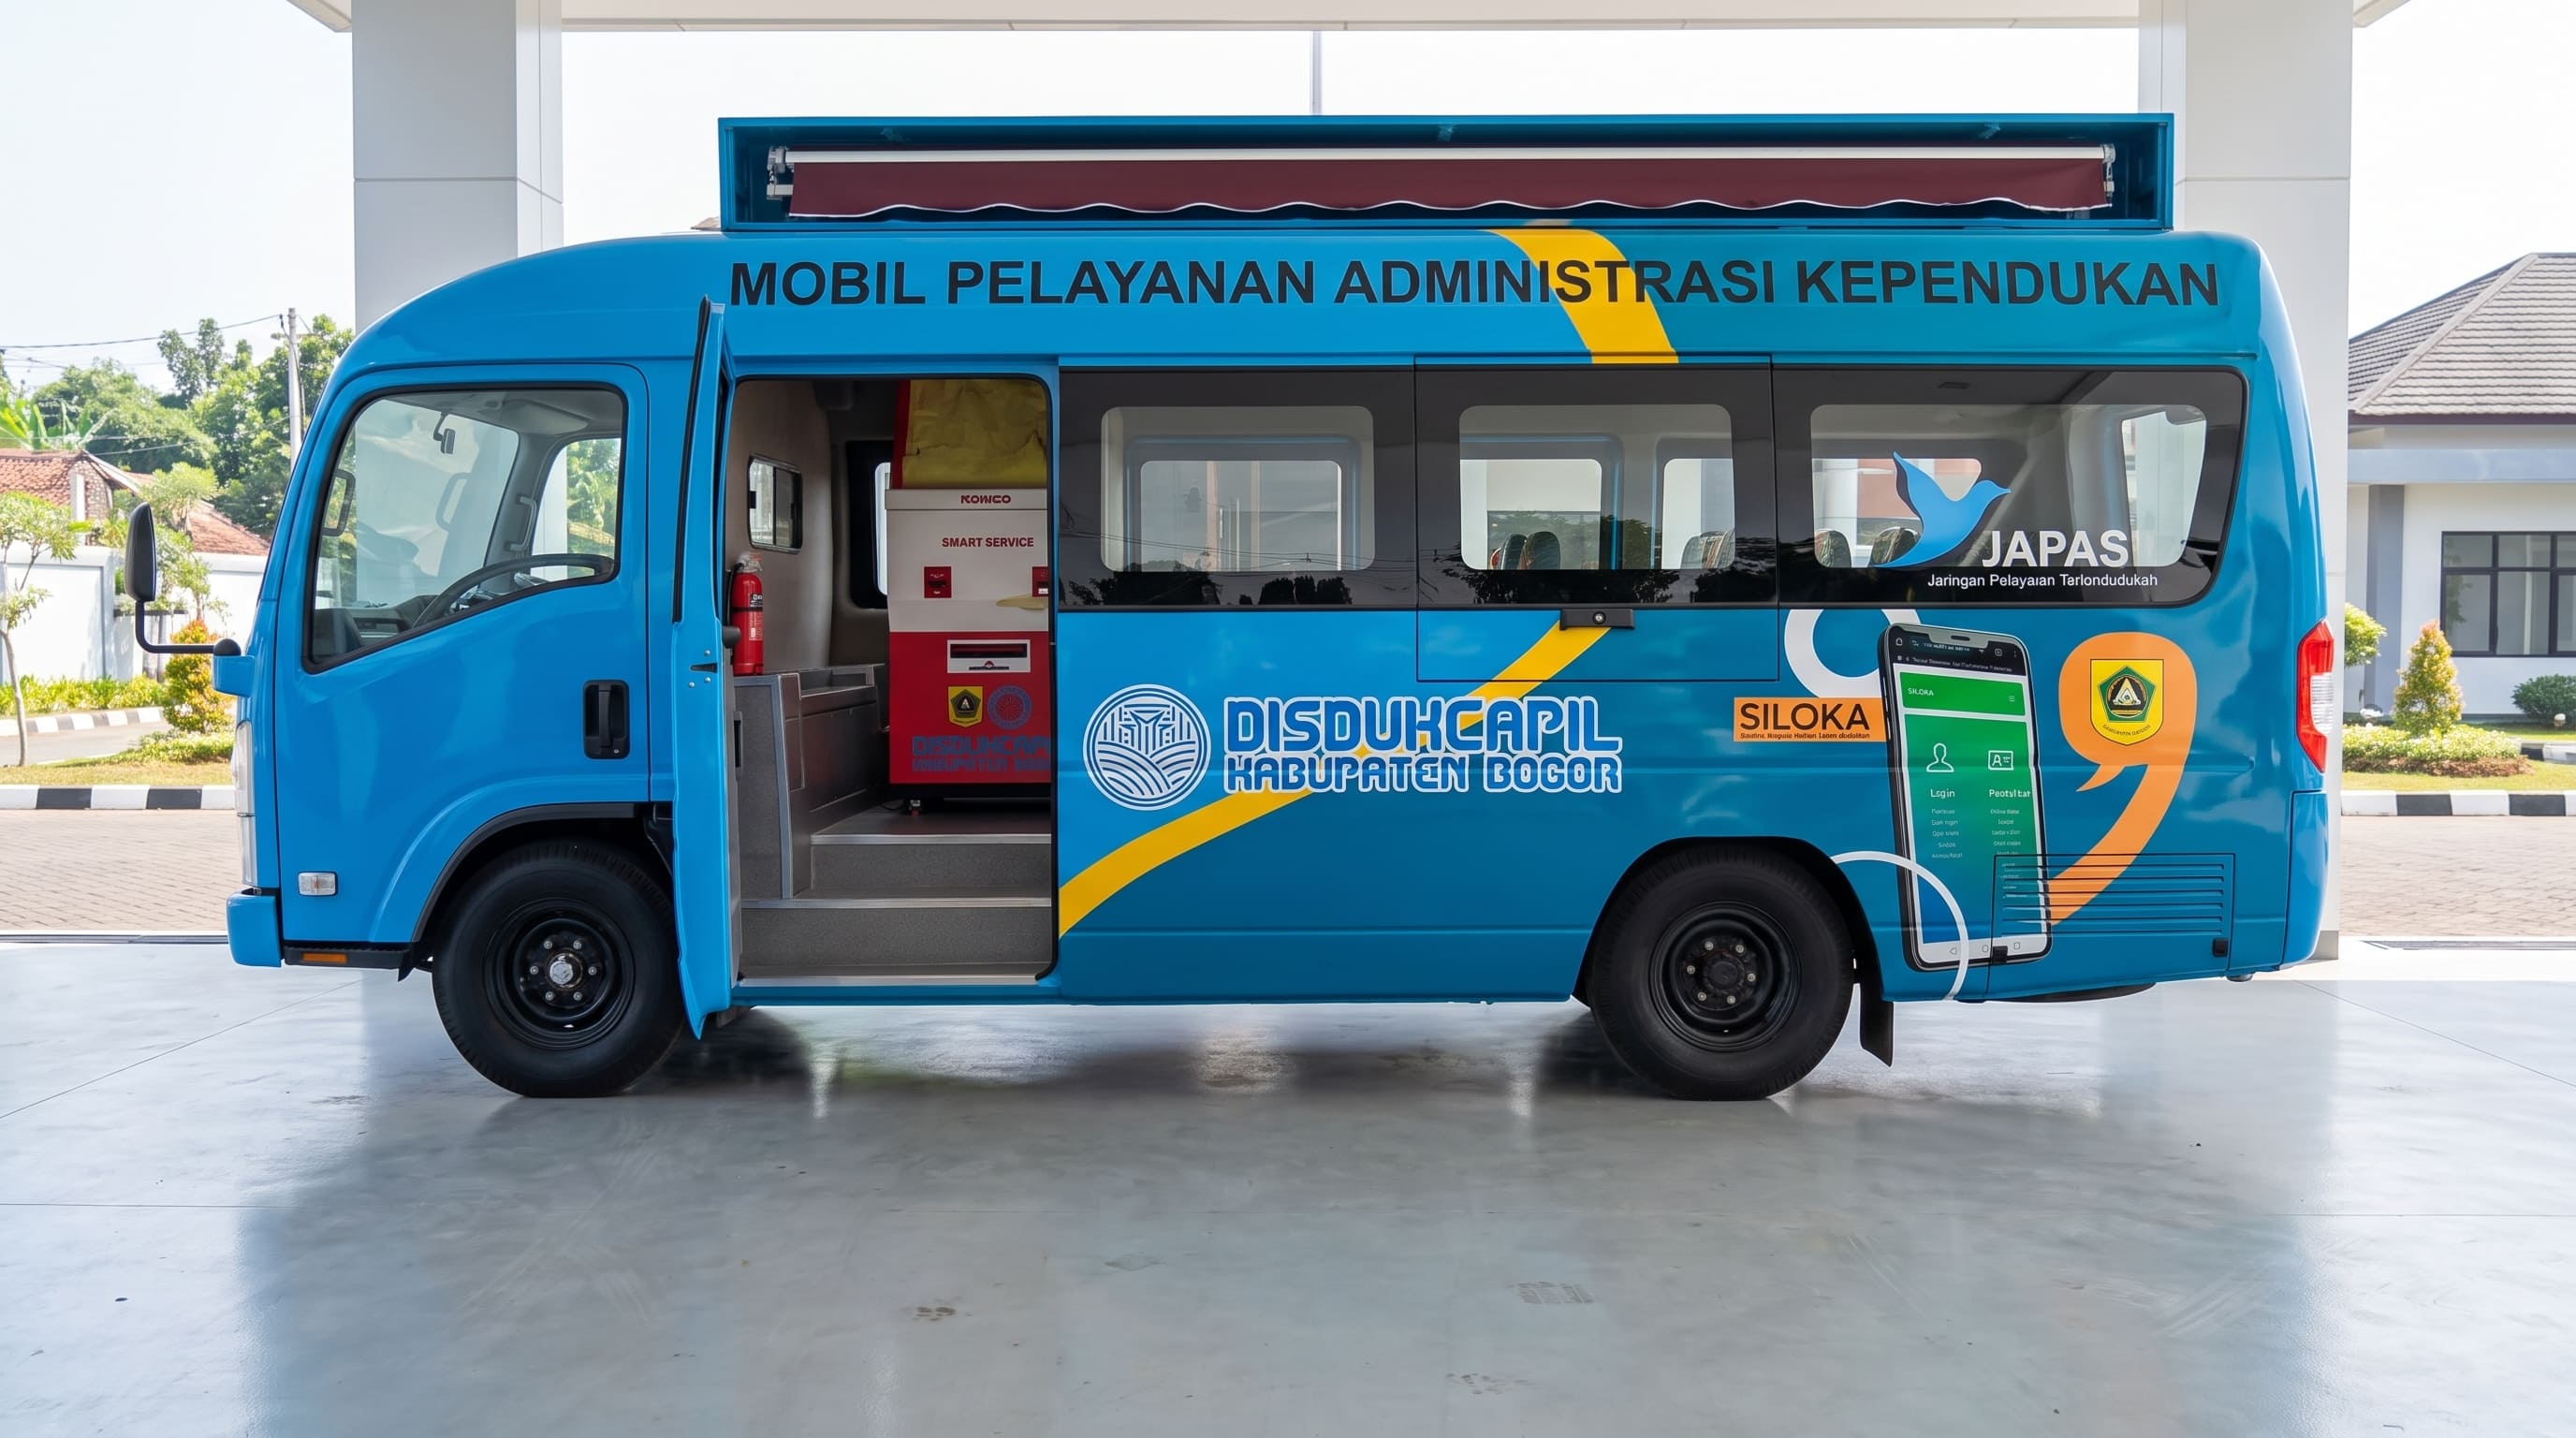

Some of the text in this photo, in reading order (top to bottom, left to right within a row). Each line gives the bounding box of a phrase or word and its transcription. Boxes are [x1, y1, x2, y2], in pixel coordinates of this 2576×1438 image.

[730, 258, 2218, 306] MOBIL PELAYANAN ADMINISTRASI KEPENDUKAN
[942, 537, 1034, 548] SMART SERVICE
[1982, 529, 2130, 568] JAPAS
[1927, 573, 1985, 589] Jaringan
[2059, 573, 2159, 587] Terlondudukah
[1223, 696, 1623, 756] DISDUKCAPIL
[1740, 702, 1870, 730] SILOKA
[1223, 752, 1622, 794] KABUPATEN BOGOR
